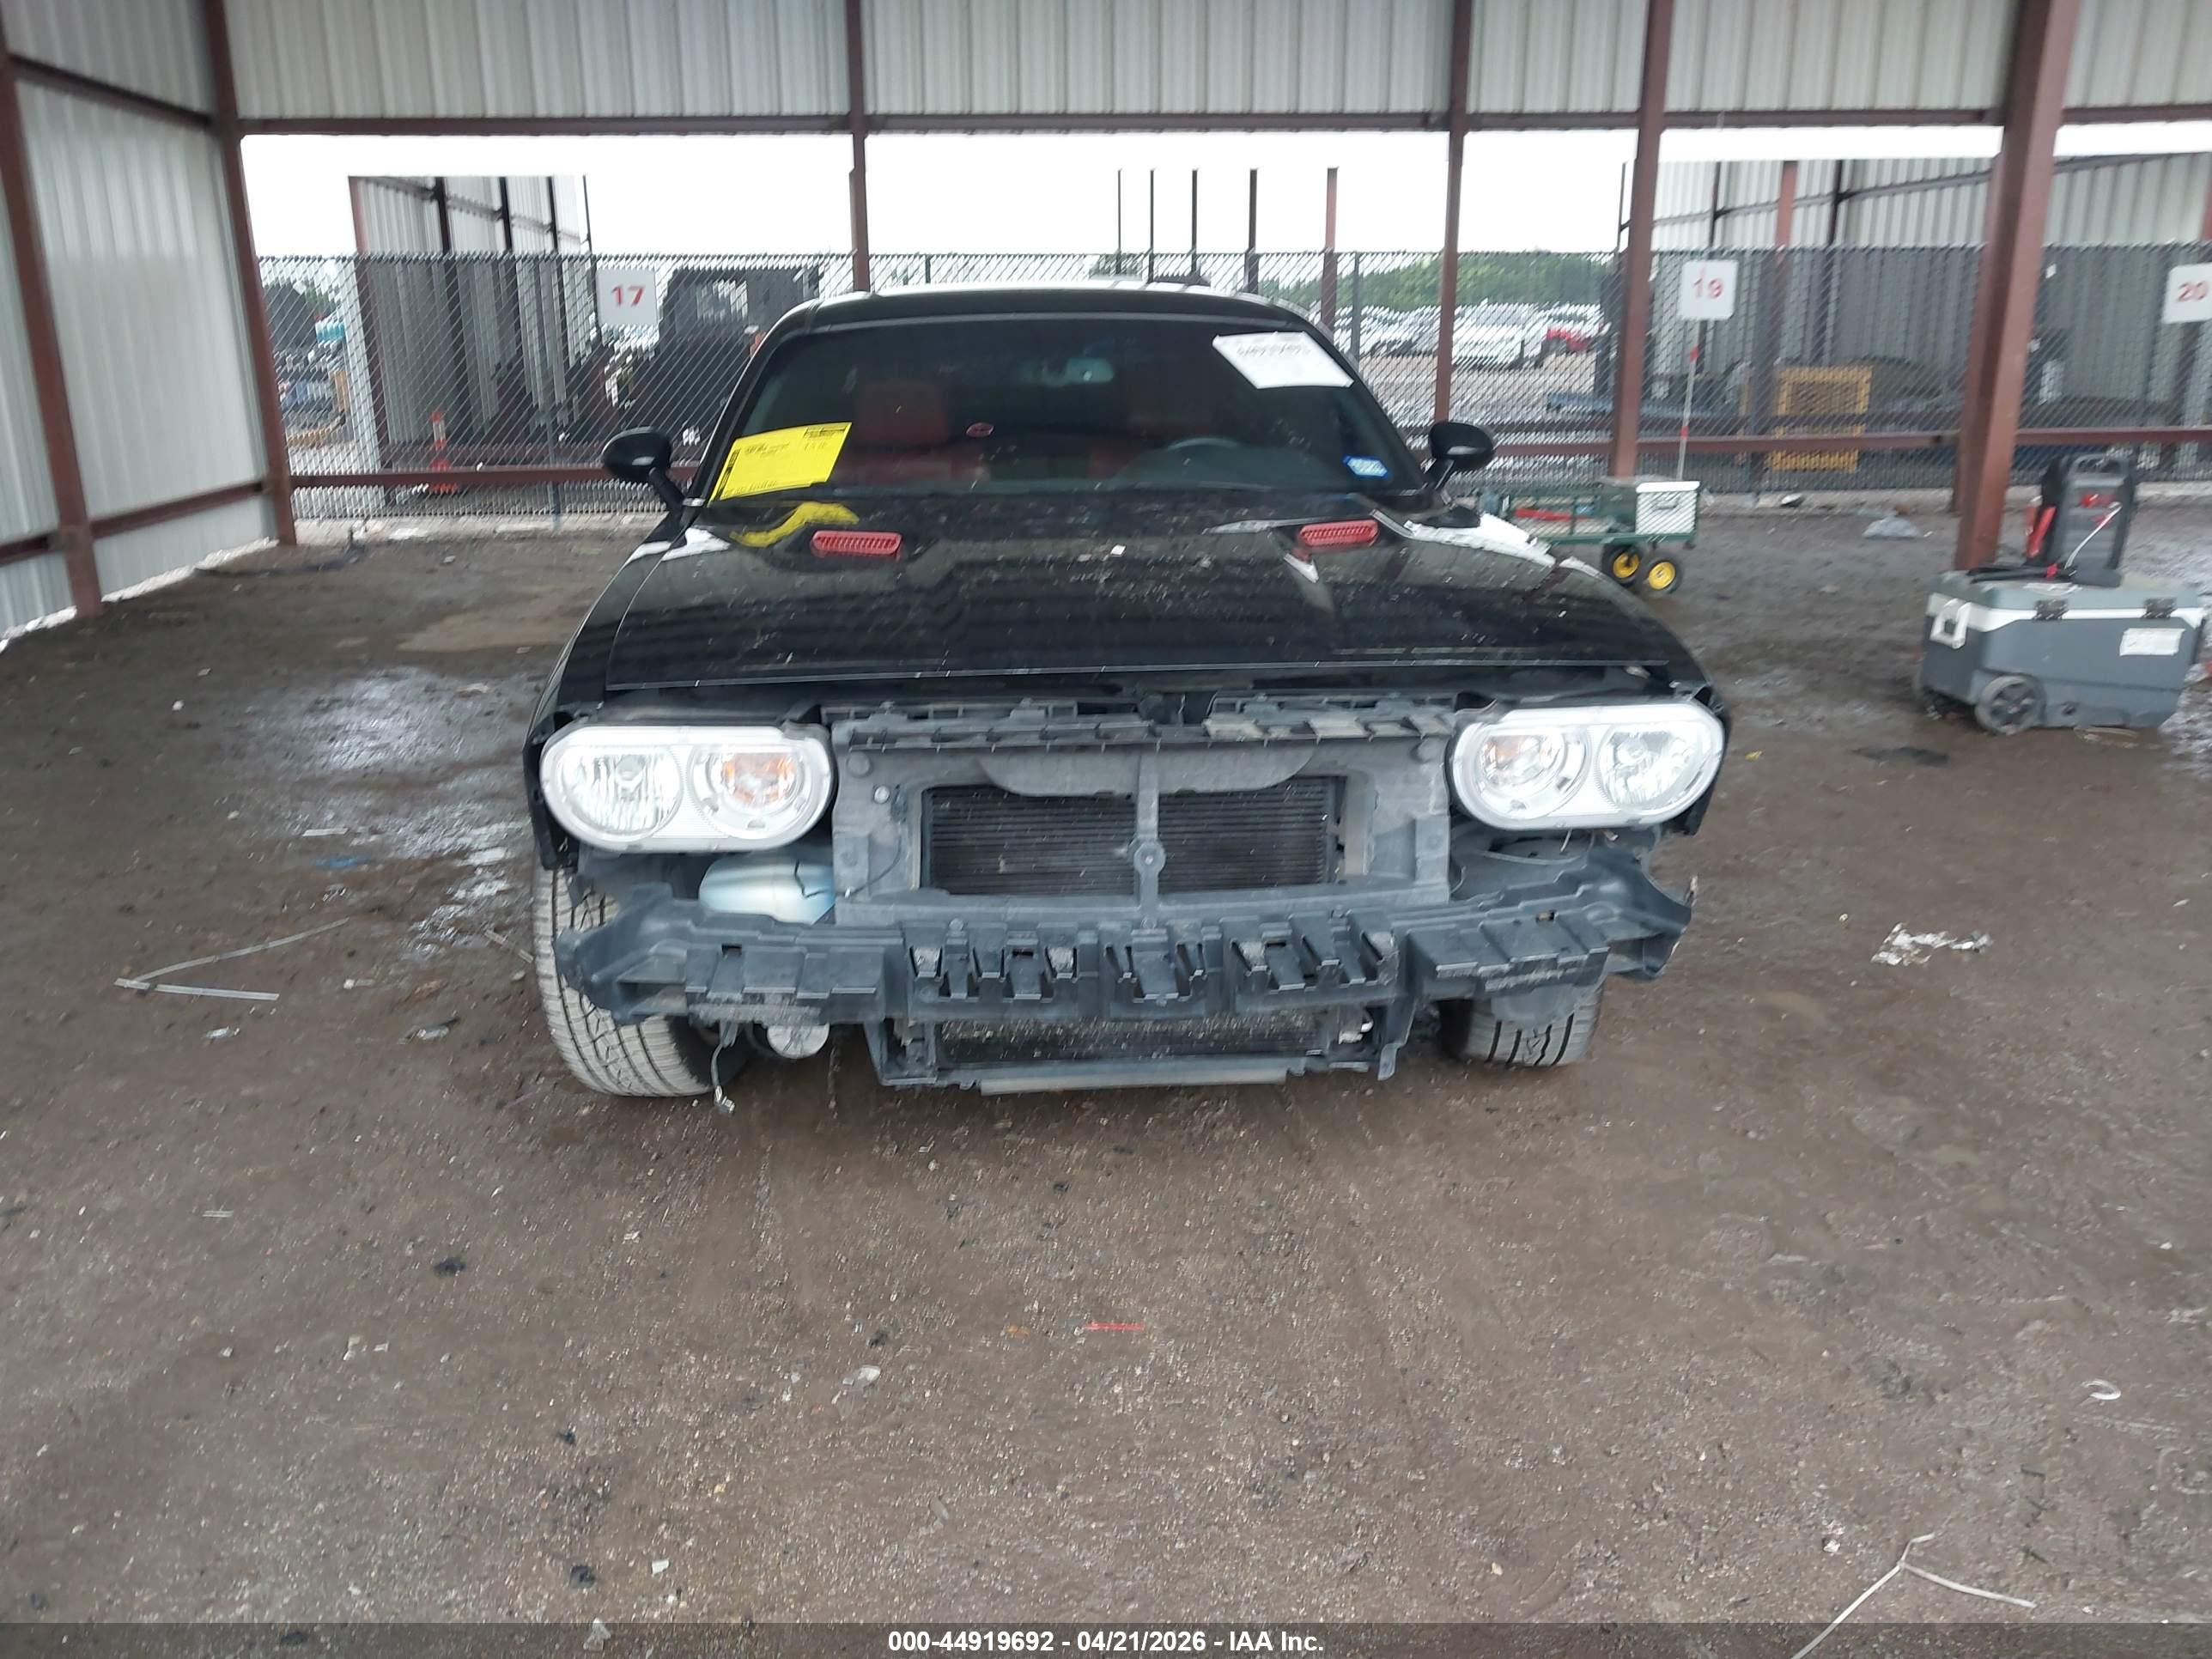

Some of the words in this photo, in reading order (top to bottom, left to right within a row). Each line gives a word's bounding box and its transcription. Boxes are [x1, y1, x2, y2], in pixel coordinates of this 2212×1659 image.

[611, 284, 645, 307] 17
[1692, 278, 1724, 300] 19
[2178, 281, 2209, 302] 20
